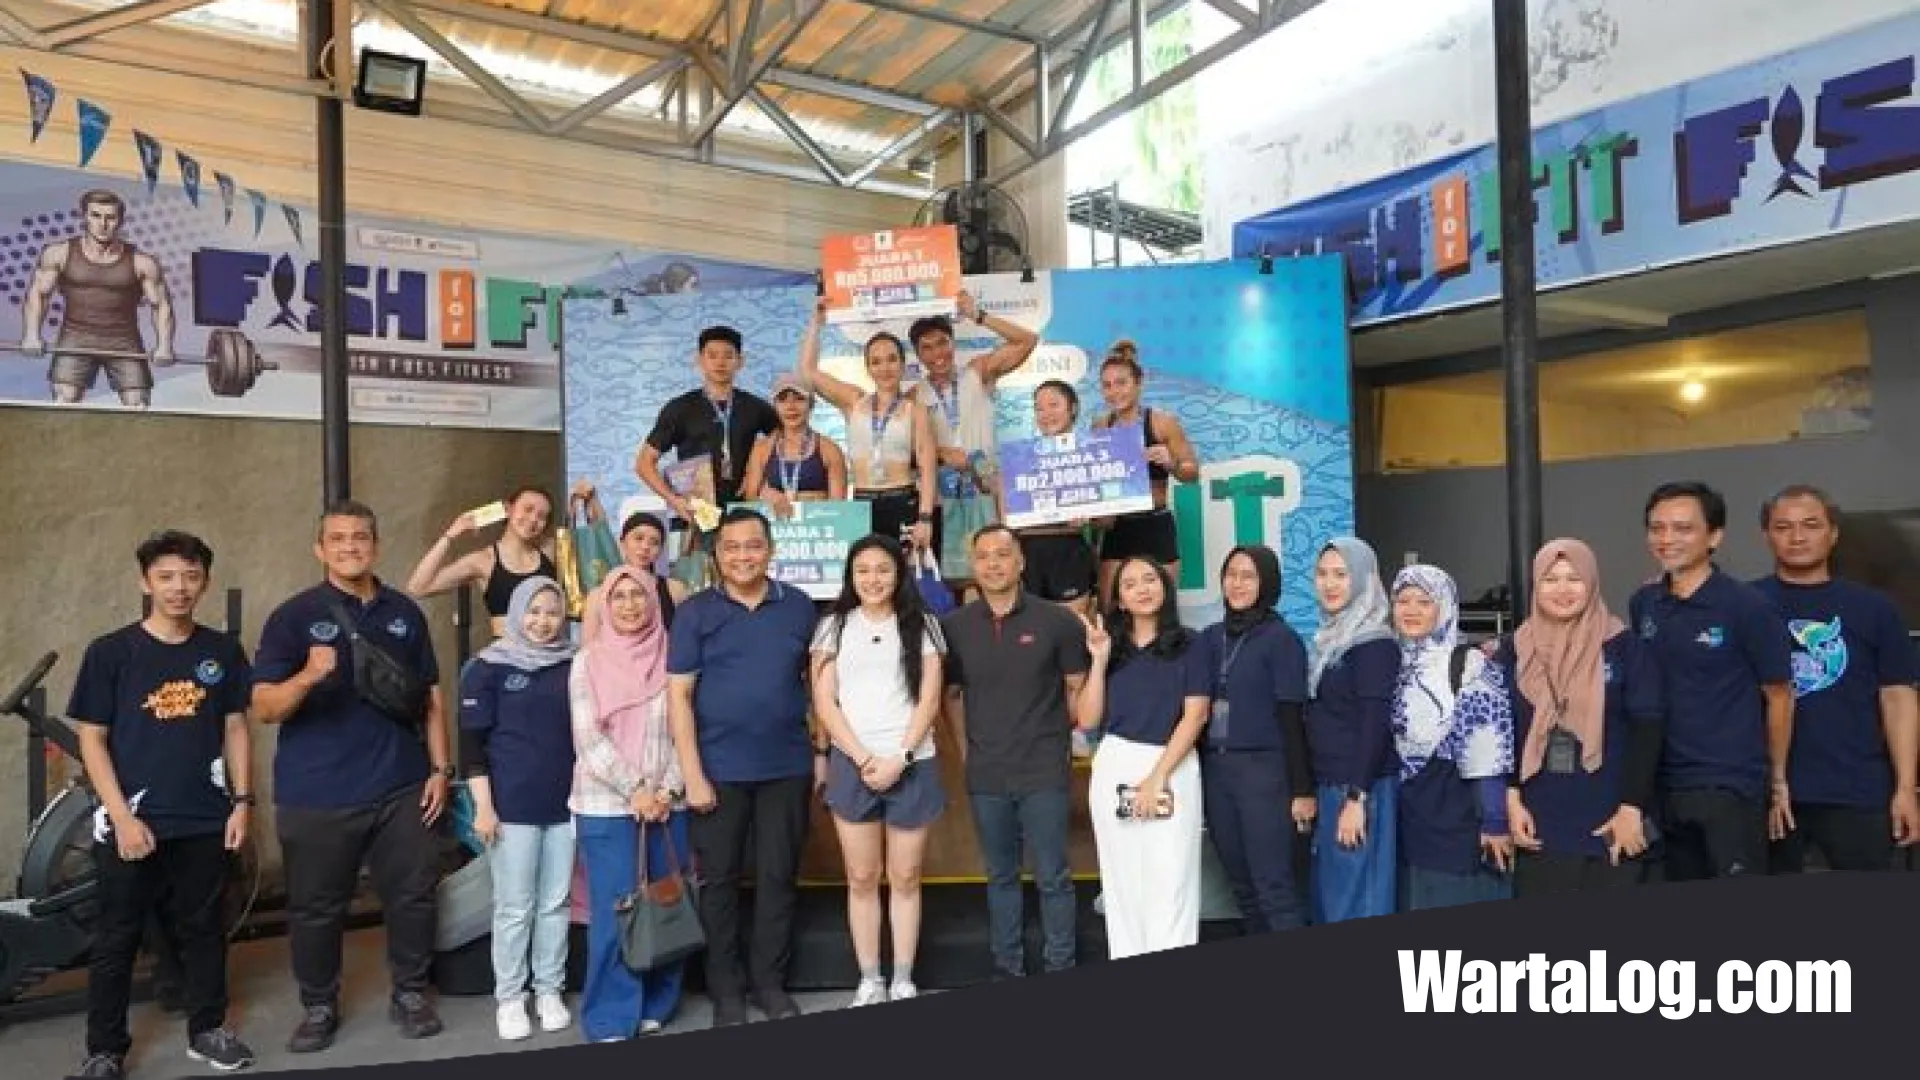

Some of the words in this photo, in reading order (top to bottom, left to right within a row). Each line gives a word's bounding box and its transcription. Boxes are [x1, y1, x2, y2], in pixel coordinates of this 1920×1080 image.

[1036, 356, 1071, 373] BNI
[771, 525, 820, 538] UARA
[1173, 471, 1284, 590] IT
